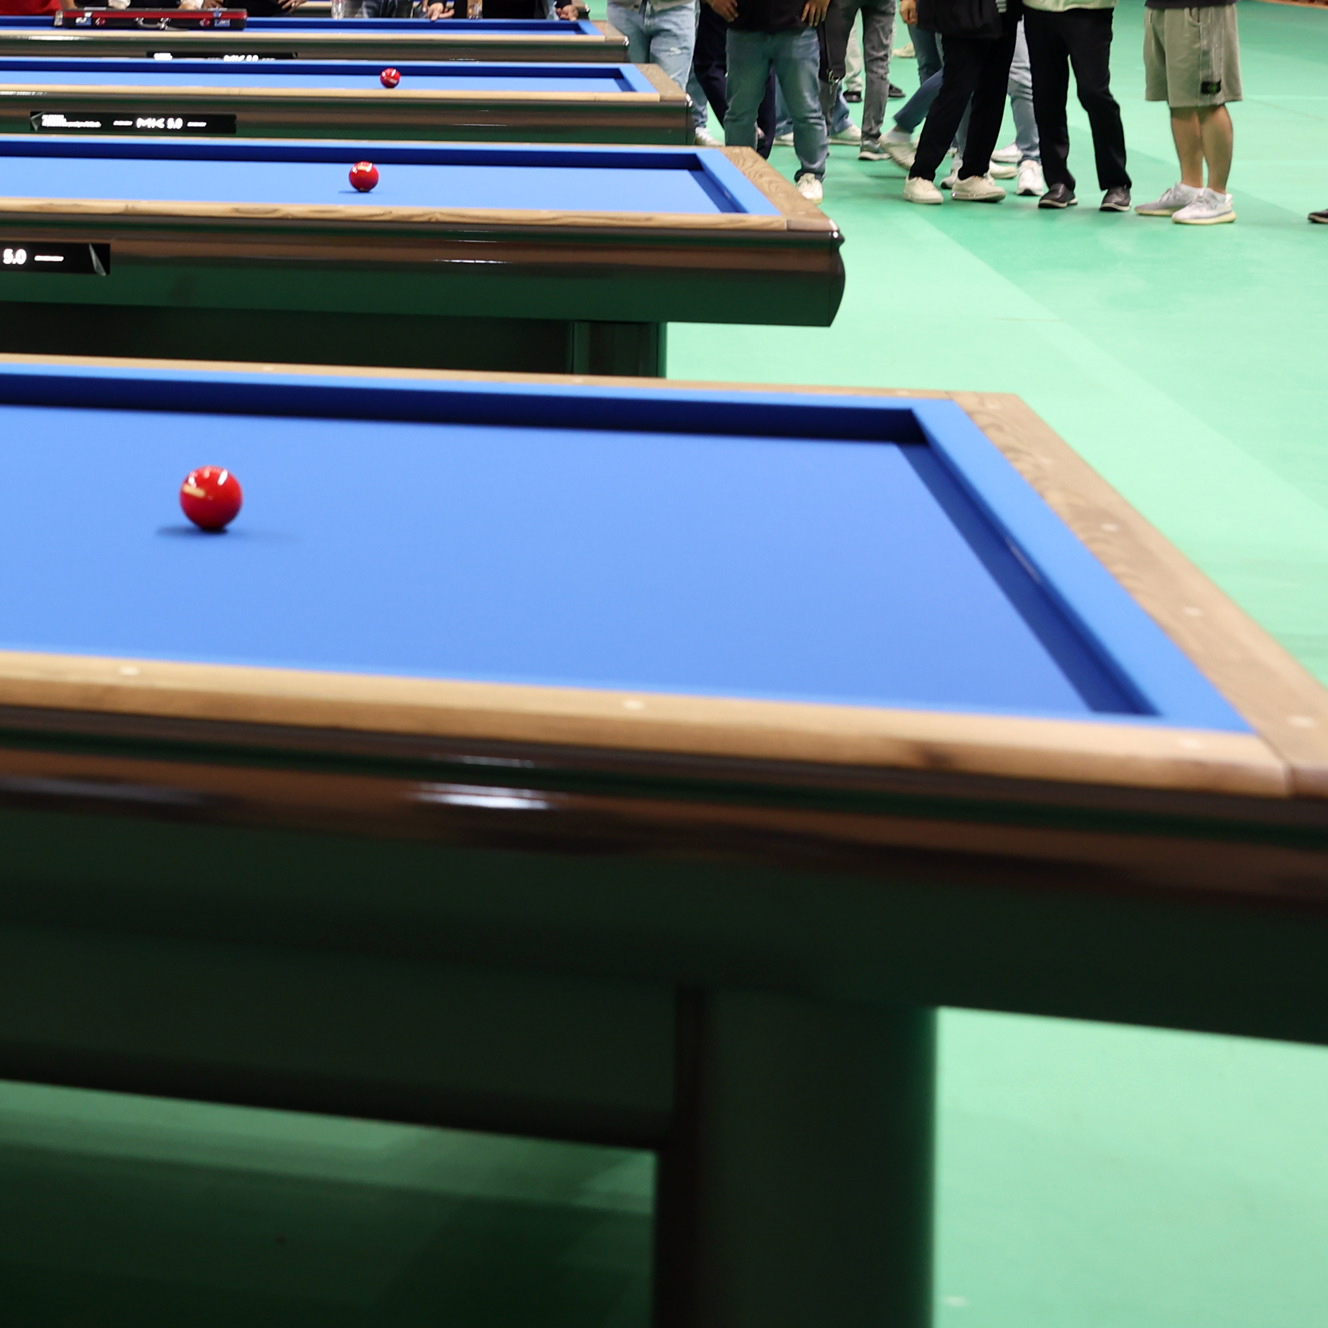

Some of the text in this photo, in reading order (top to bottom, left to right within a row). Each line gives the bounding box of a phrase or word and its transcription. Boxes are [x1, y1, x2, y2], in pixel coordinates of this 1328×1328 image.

[136, 117, 183, 129] MK 5.0
[3, 248, 27, 265] 5.0
